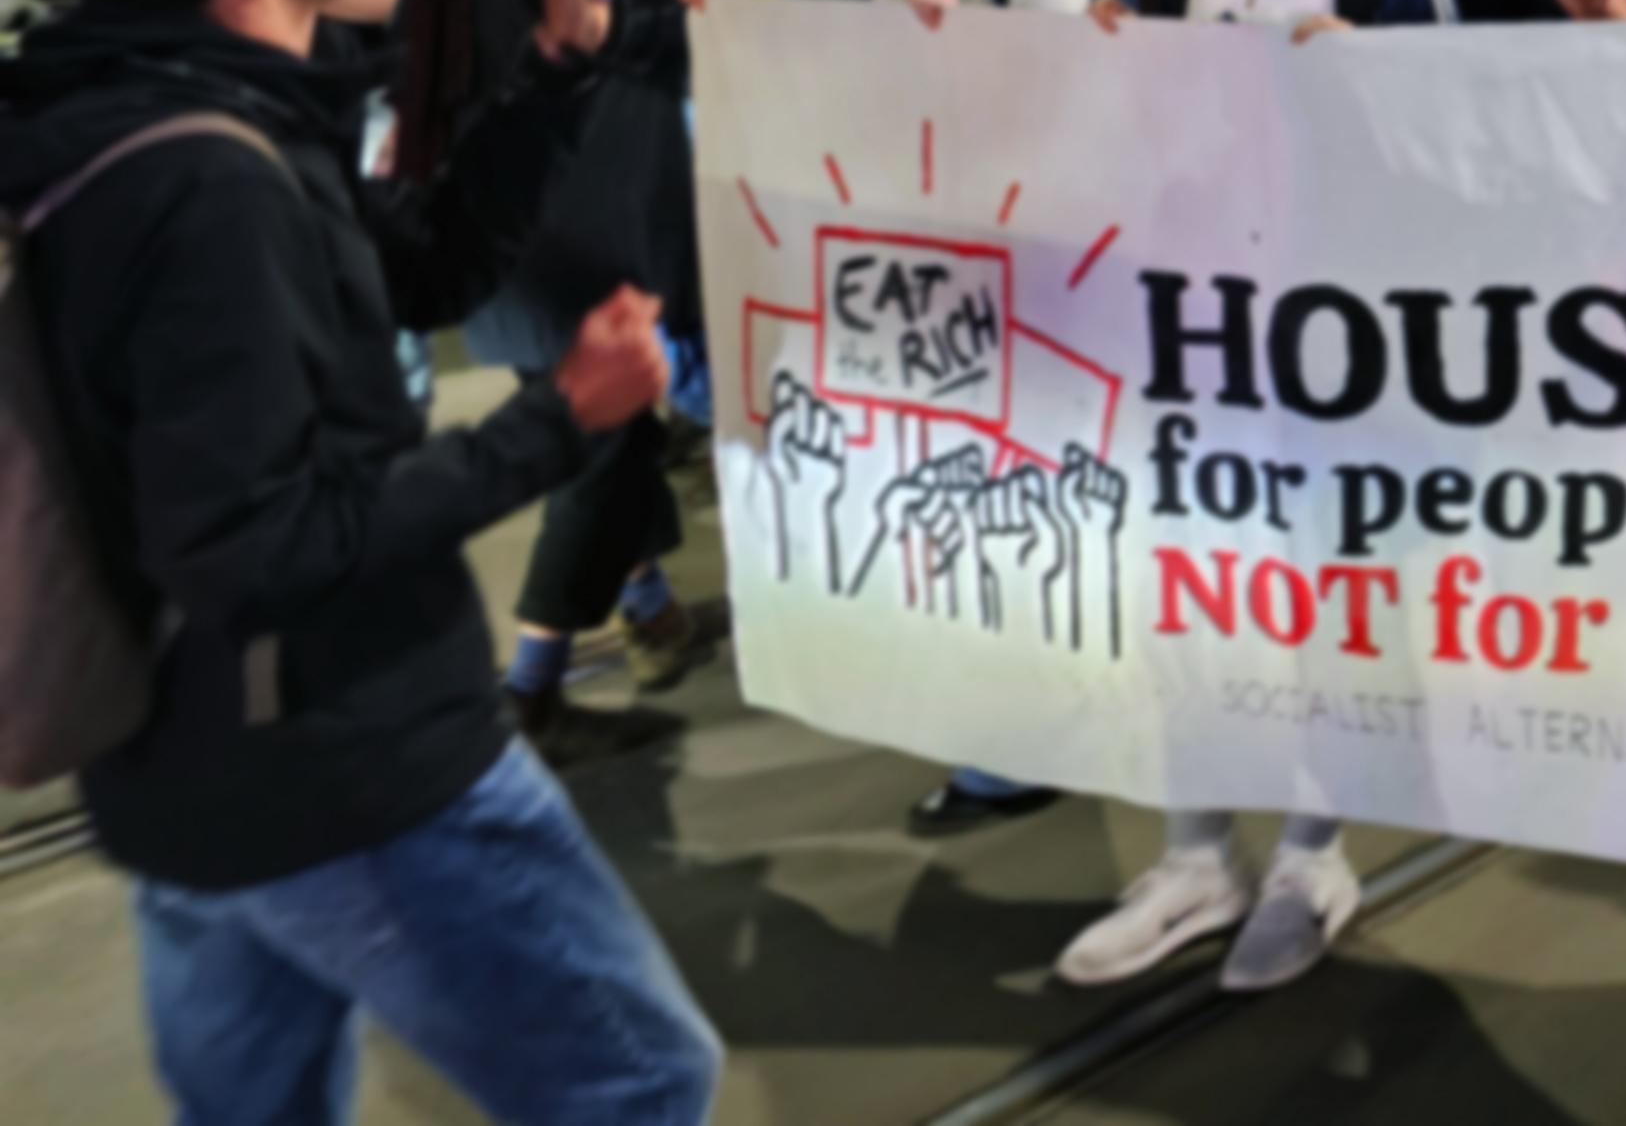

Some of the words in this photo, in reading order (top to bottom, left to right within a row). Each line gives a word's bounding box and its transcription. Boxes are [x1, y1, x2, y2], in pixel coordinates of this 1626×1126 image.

[832, 254, 952, 333] EAT
[837, 336, 889, 388] the
[899, 285, 998, 389] RICH
[1149, 413, 1306, 530] for
[1152, 546, 1400, 658] NOT
[1428, 554, 1611, 674] for
[1219, 678, 1426, 742] SOCIALIST
